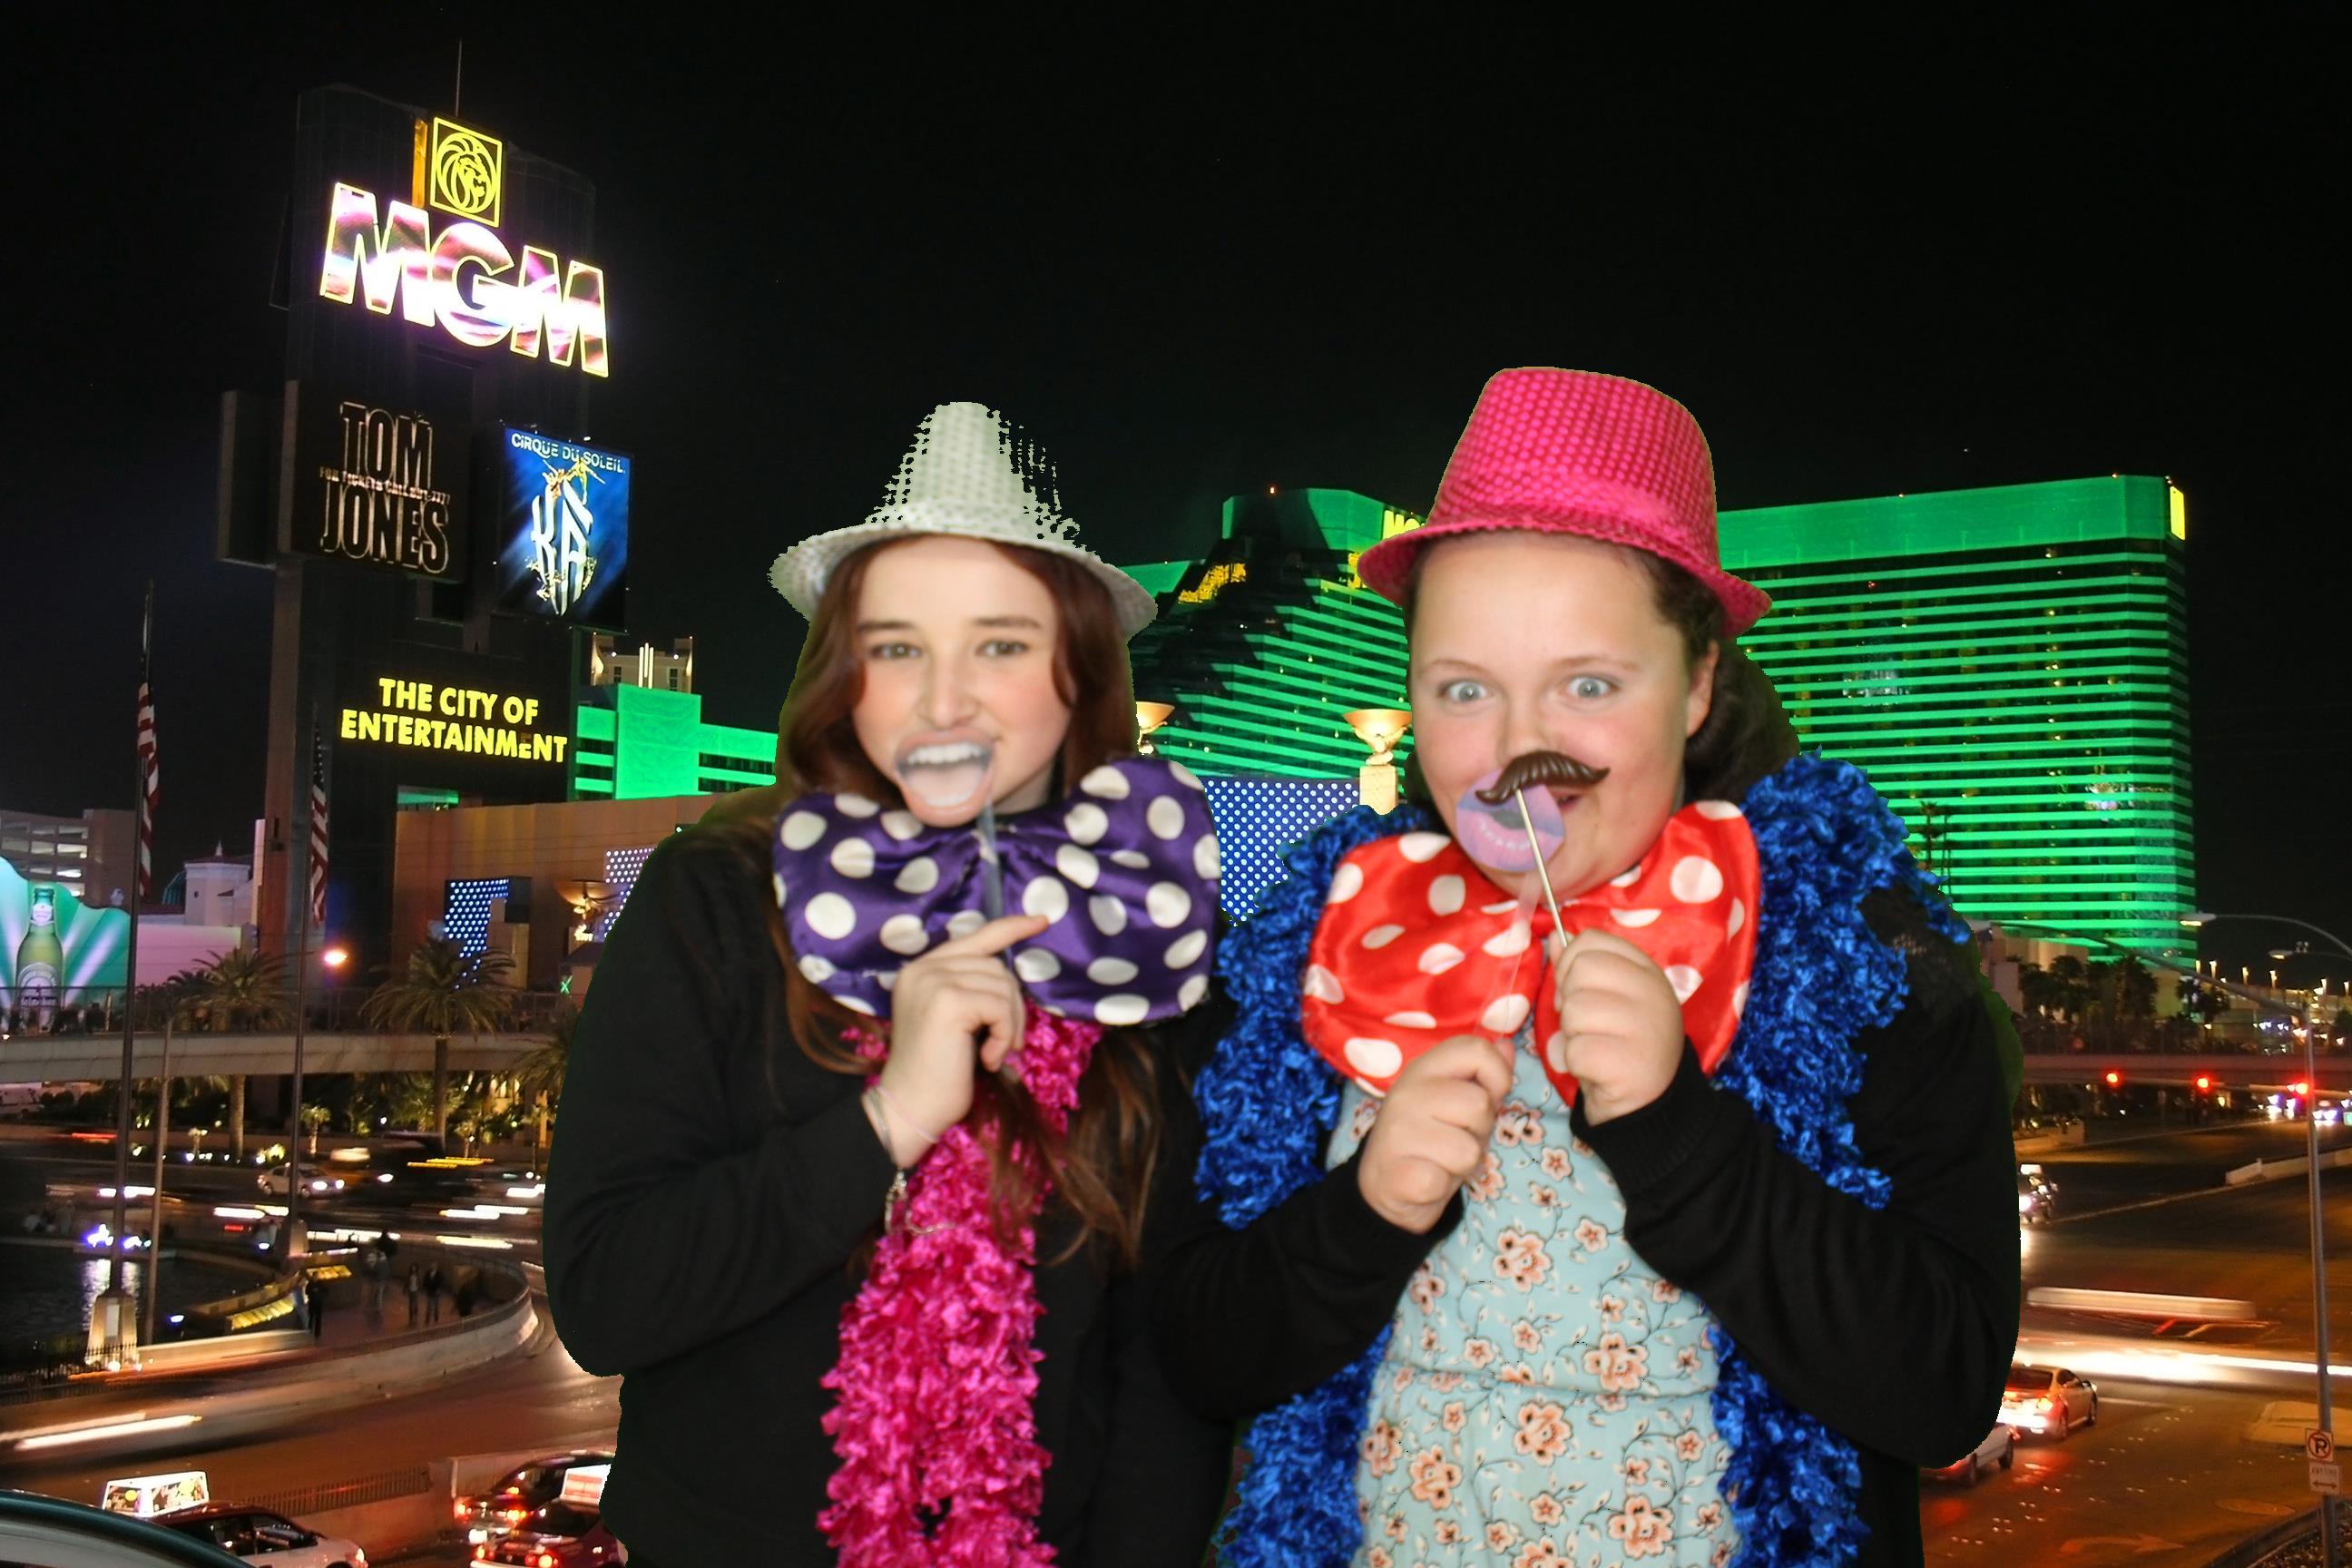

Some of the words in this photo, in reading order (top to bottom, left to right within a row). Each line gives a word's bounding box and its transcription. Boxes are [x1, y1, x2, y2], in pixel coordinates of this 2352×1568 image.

[319, 182, 609, 377] MGM
[339, 401, 433, 489] TOM
[511, 433, 559, 458] CIRQUE
[563, 446, 580, 462] DU
[583, 451, 623, 473] SOLEIL
[320, 481, 449, 573] JONES
[341, 709, 567, 762] ENTERTAINMENT
[378, 677, 433, 712] THE
[439, 687, 498, 720] CITY
[503, 696, 539, 725] OF
